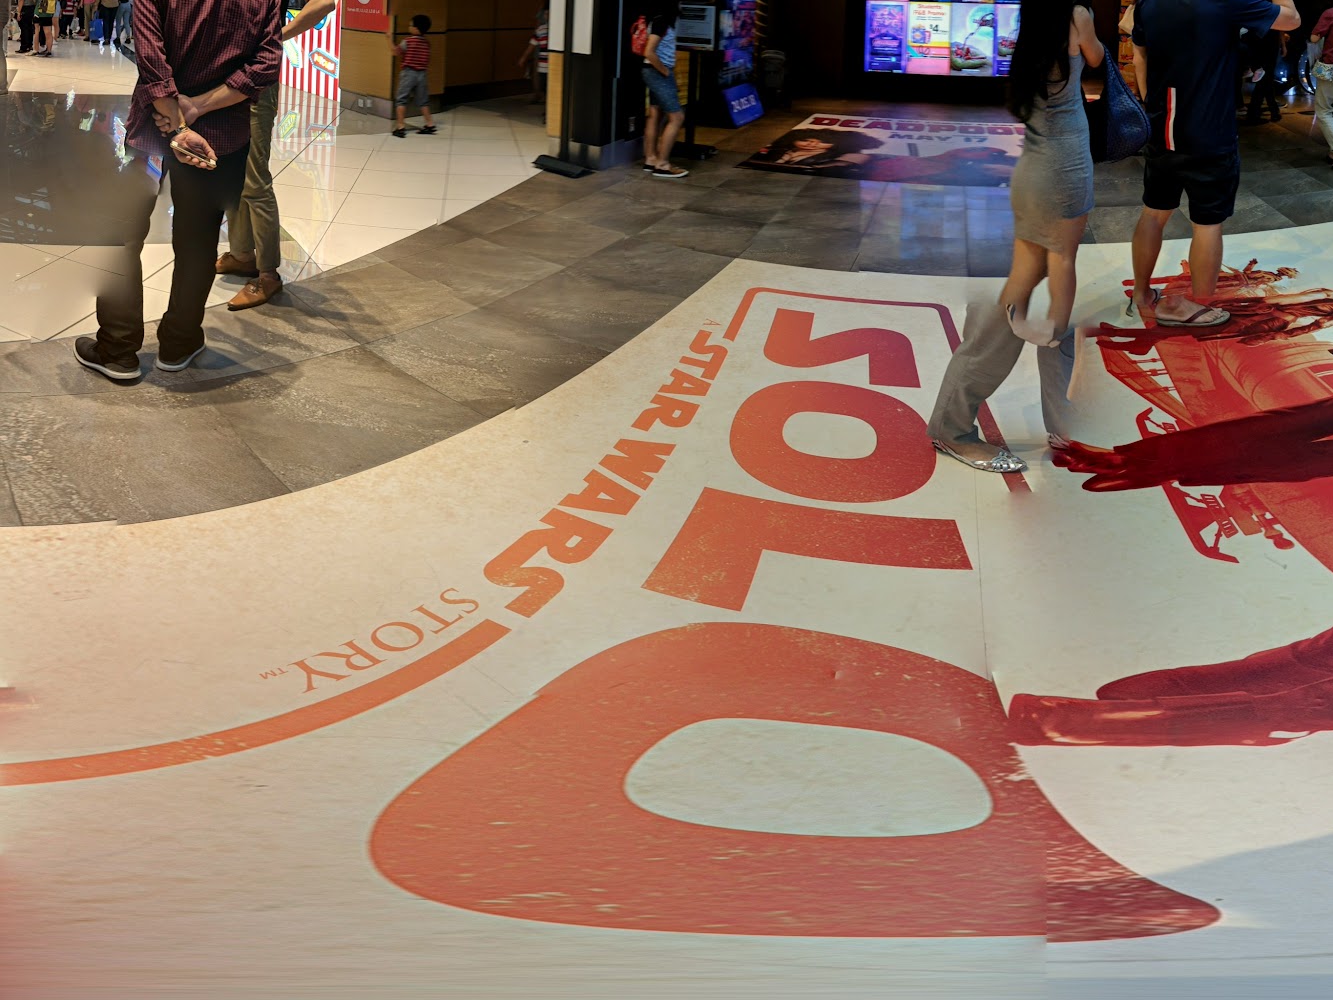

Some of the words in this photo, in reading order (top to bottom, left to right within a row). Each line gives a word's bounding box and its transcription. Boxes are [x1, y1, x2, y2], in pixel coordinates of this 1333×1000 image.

[630, 329, 728, 432] STAR
[483, 438, 677, 619] WARS
[287, 587, 480, 694] STORY
